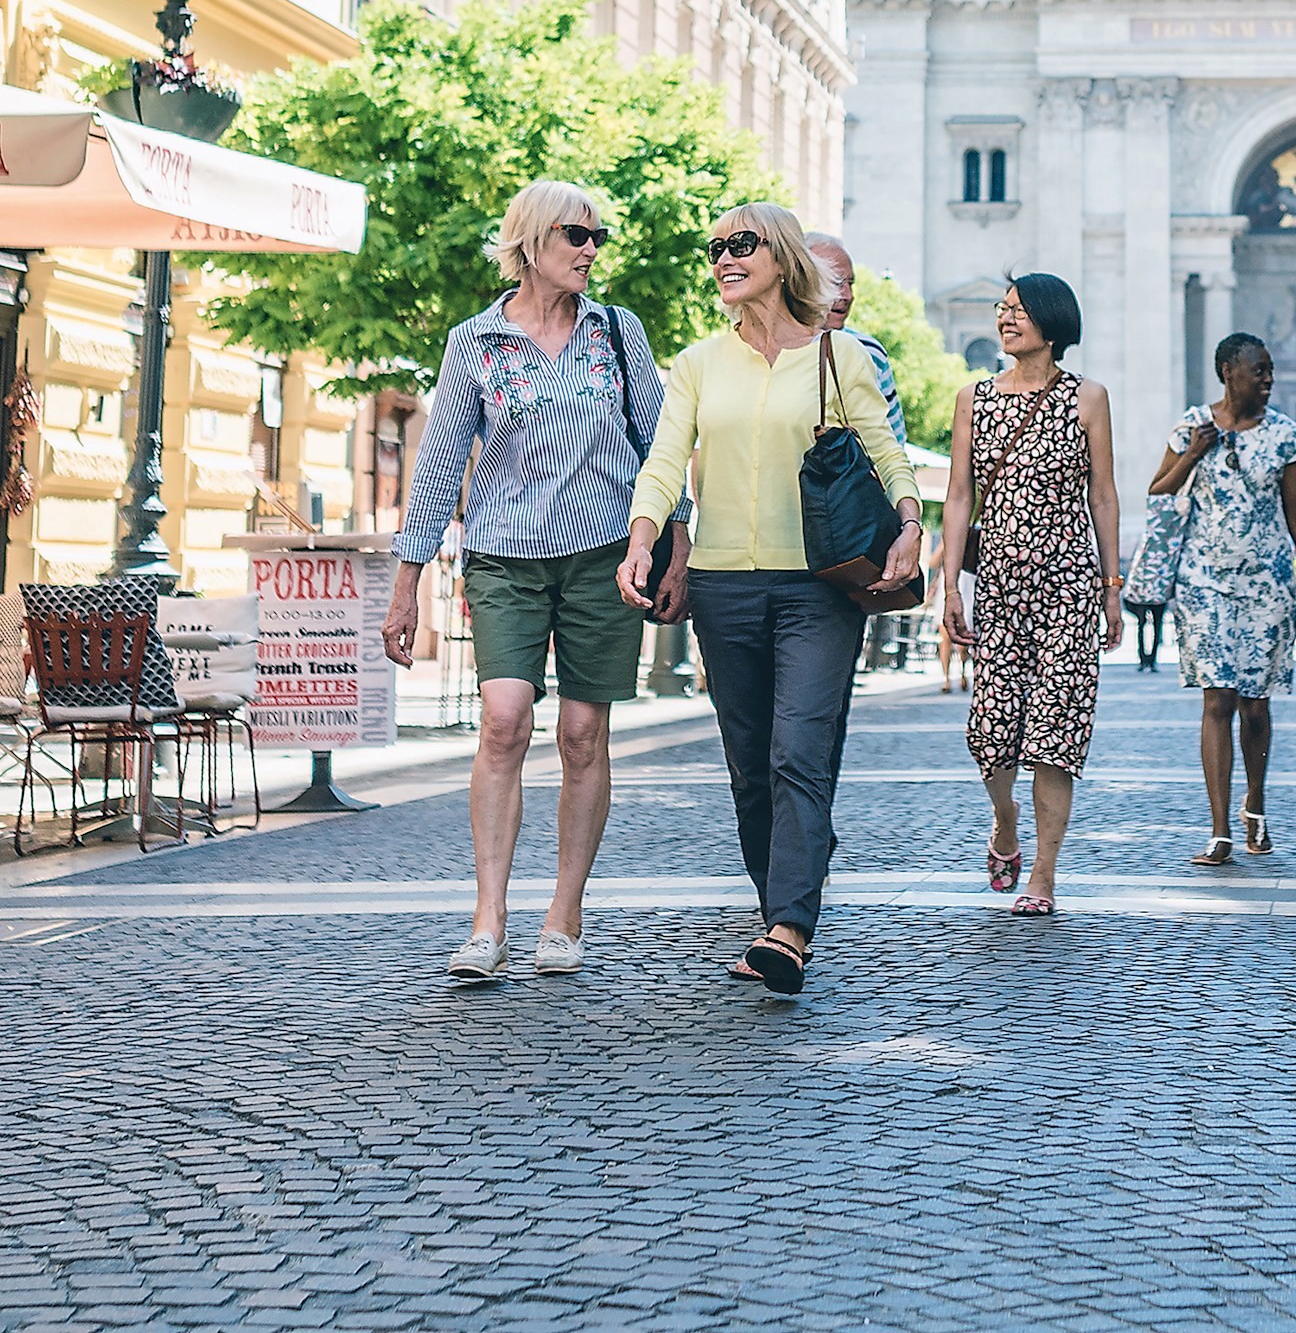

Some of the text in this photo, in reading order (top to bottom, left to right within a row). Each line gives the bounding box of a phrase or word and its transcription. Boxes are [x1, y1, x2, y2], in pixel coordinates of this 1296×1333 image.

[291, 183, 336, 237] PORTA
[253, 558, 359, 600] PORTA
[256, 642, 358, 658] UTTER CROISSANT
[249, 709, 358, 726] MUESLI VARIATIONS
